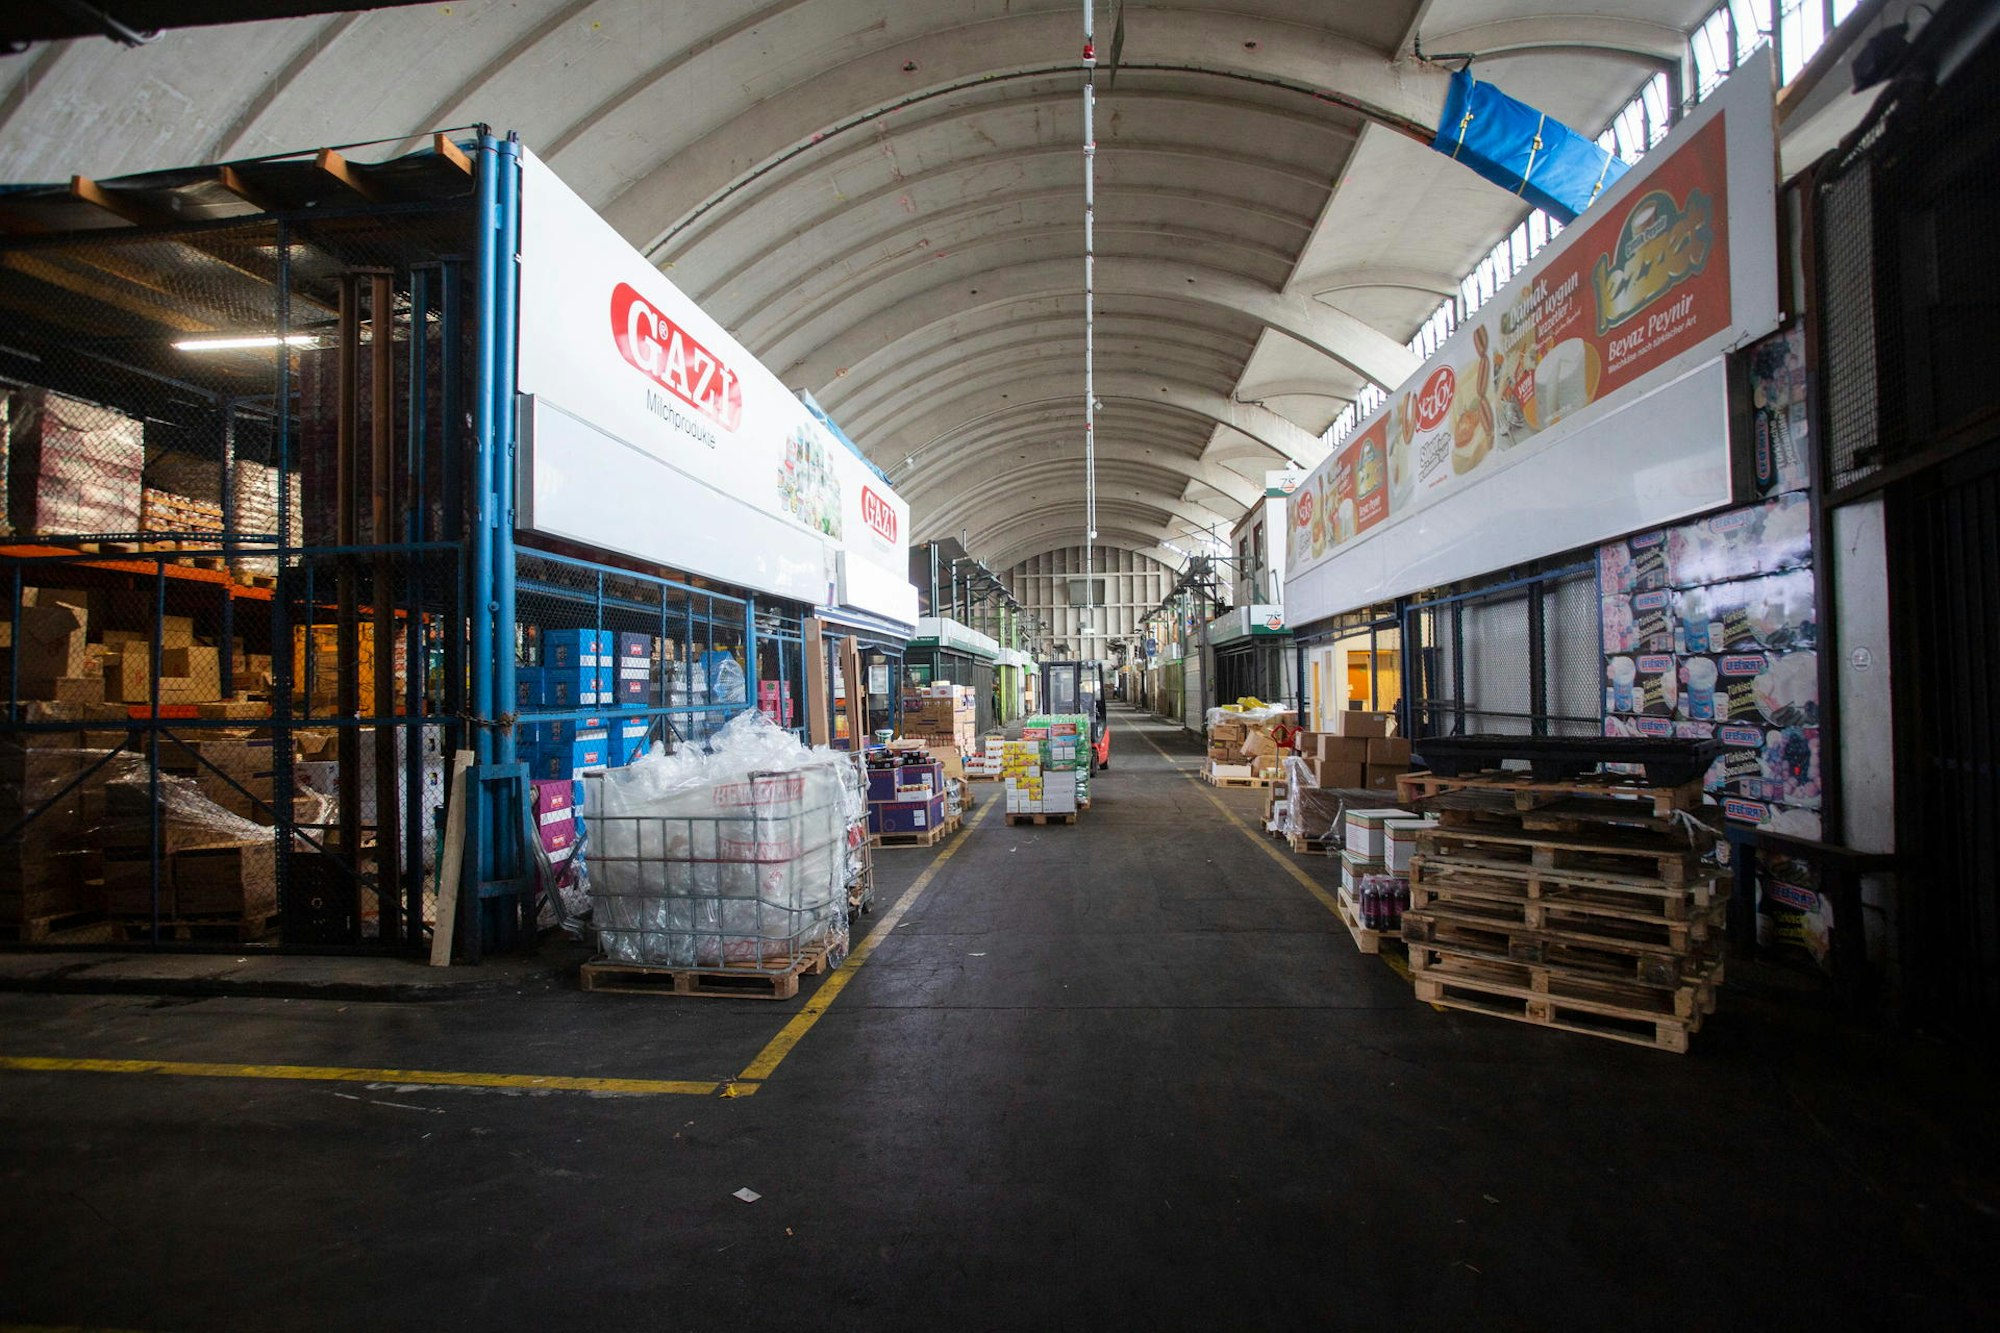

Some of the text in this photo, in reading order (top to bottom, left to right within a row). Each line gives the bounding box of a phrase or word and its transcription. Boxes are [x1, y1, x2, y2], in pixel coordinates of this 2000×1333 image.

[1545, 271, 1579, 318] uygun
[1608, 322, 1645, 361] Beyaz
[1648, 294, 1694, 338] Peynir
[646, 388, 716, 449] Milchprodukte
[1727, 680, 1754, 697] Türkisc
